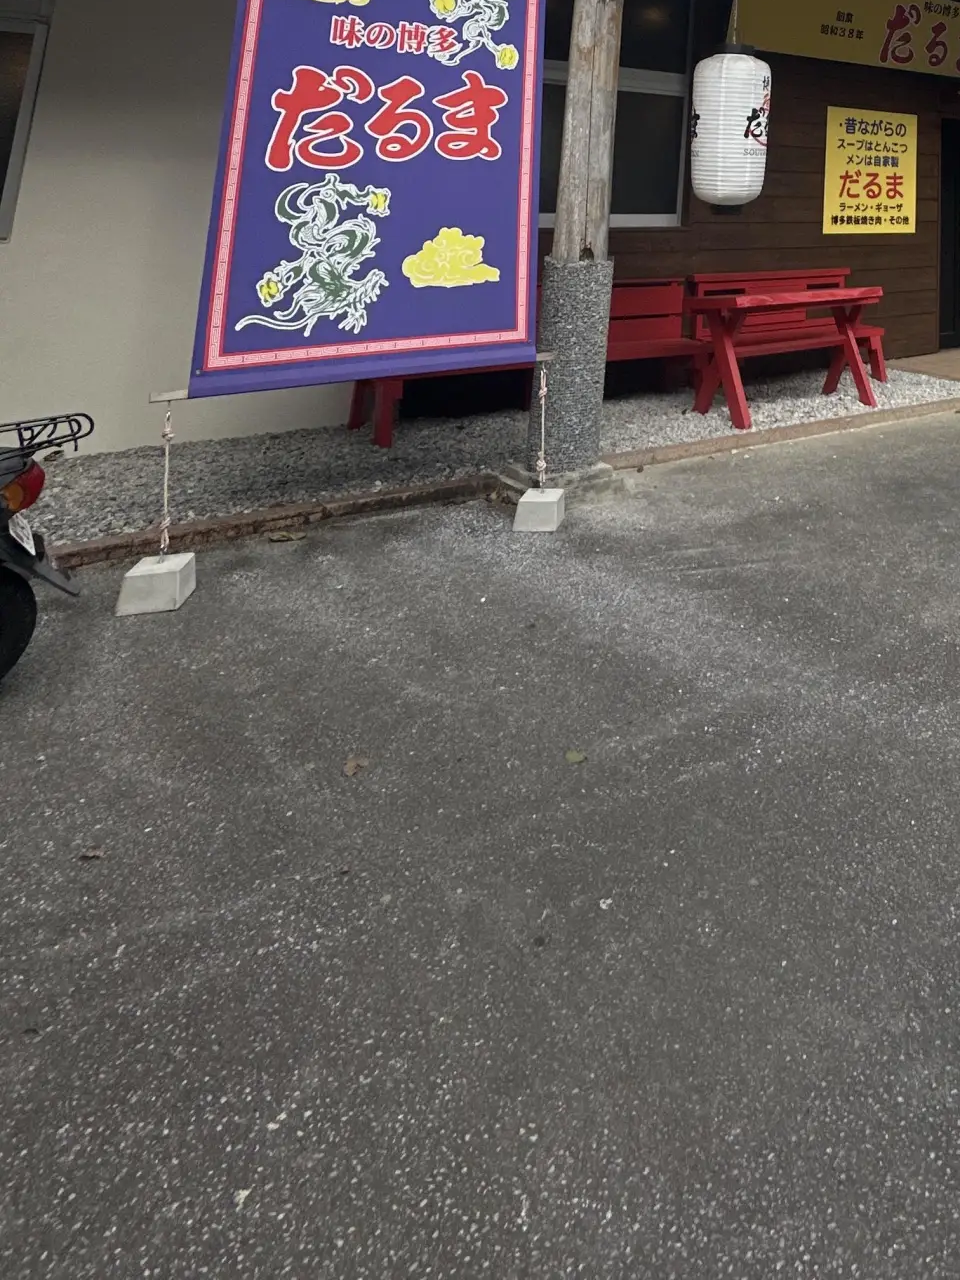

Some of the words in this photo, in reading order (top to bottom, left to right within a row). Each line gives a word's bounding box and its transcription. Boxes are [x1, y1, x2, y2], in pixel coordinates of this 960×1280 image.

[923, 1, 960, 19] 味の博多
[329, 14, 462, 56] 味の博多
[264, 64, 509, 172] だるま
[837, 138, 908, 153] スープはとんこつ
[846, 154, 899, 167] メンは自家製
[839, 169, 904, 199] だるま
